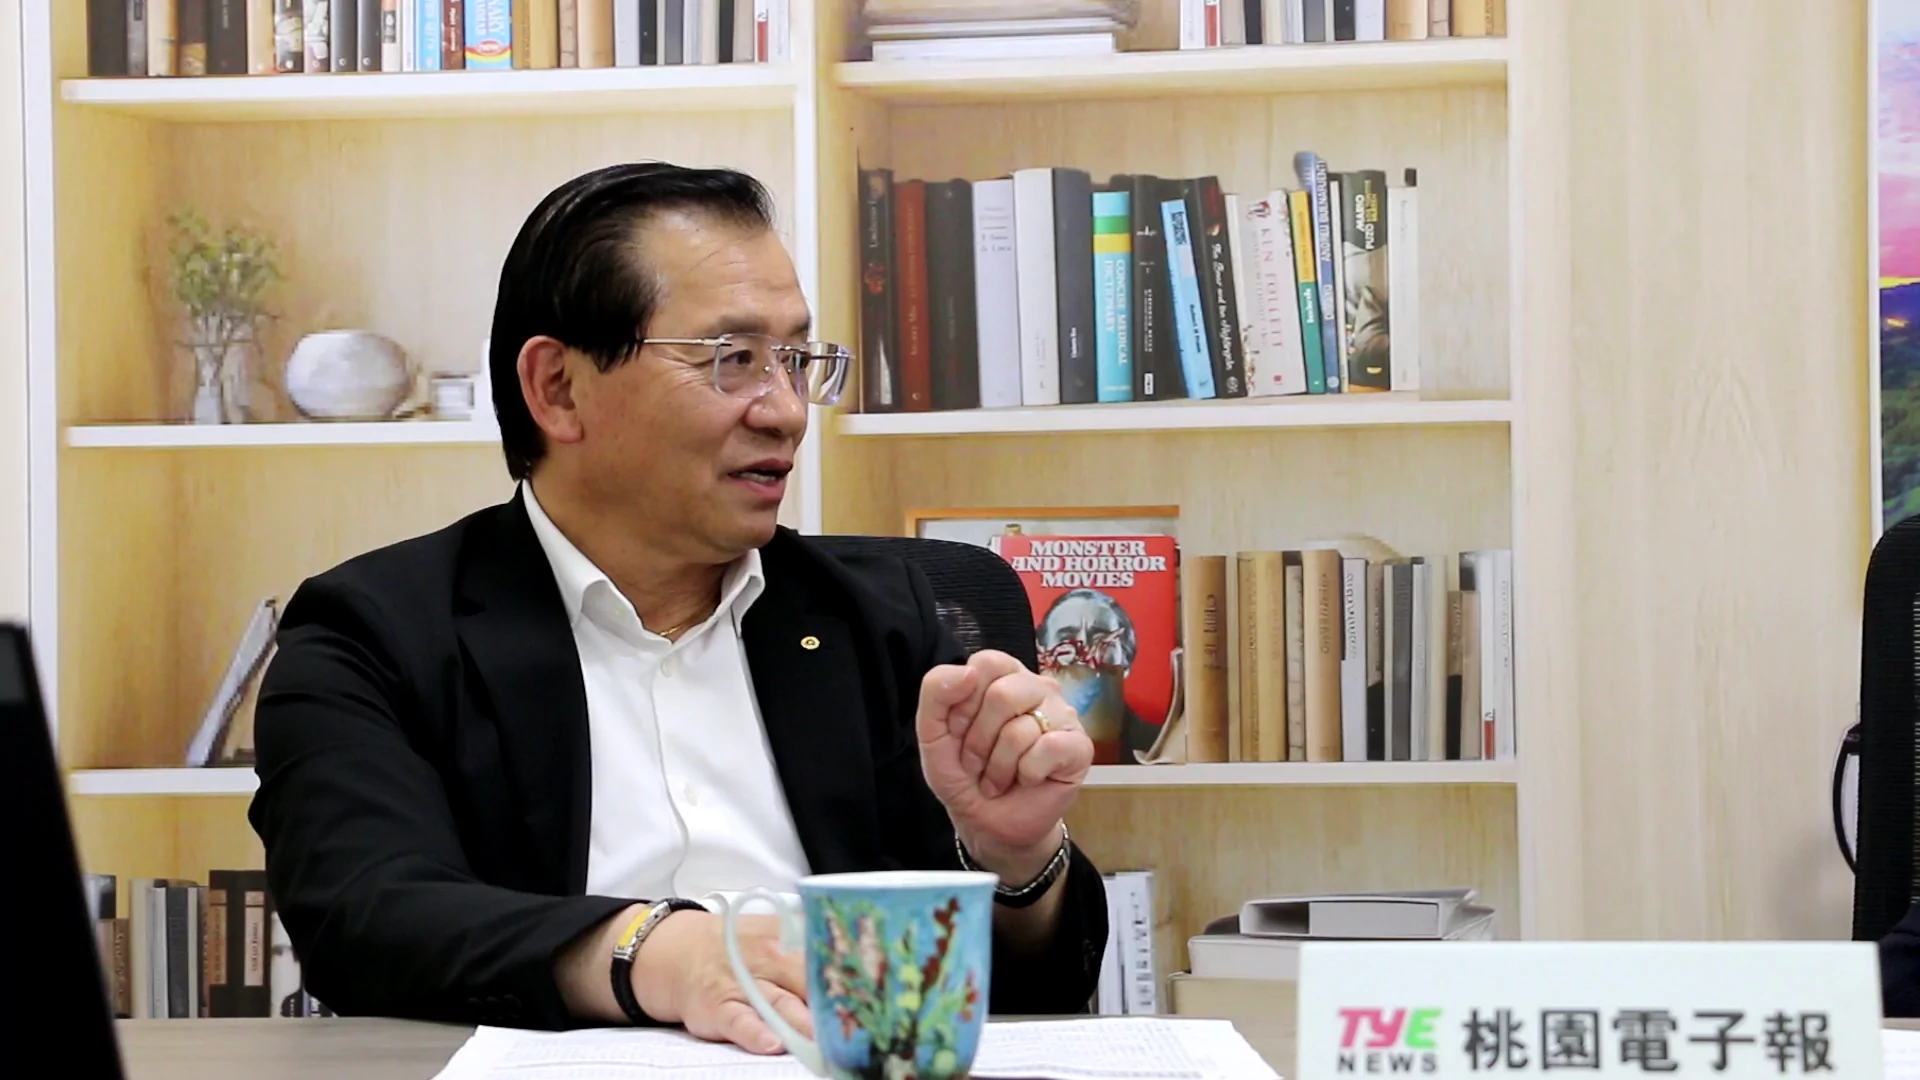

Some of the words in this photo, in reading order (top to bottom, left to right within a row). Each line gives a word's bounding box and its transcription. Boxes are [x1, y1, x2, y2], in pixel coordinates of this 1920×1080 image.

[1355, 194, 1365, 232] MARIO
[1261, 227, 1274, 262] KEN
[1365, 223, 1375, 250] PUZO
[1105, 260, 1115, 332] DICTIONARY
[1116, 259, 1127, 309] CONCISE
[1265, 272, 1284, 348] FOLLETT
[1118, 313, 1128, 366] MEDICAL
[1012, 556, 1060, 571] AND
[1064, 556, 1166, 571] HORROR
[1030, 540, 1146, 556] MONSTER
[1042, 572, 1135, 587] MOVIES
[1338, 1008, 1442, 1048] TYE
[1462, 1008, 1833, 1072] 桃園電子報
[1338, 1053, 1437, 1073] NEWS
